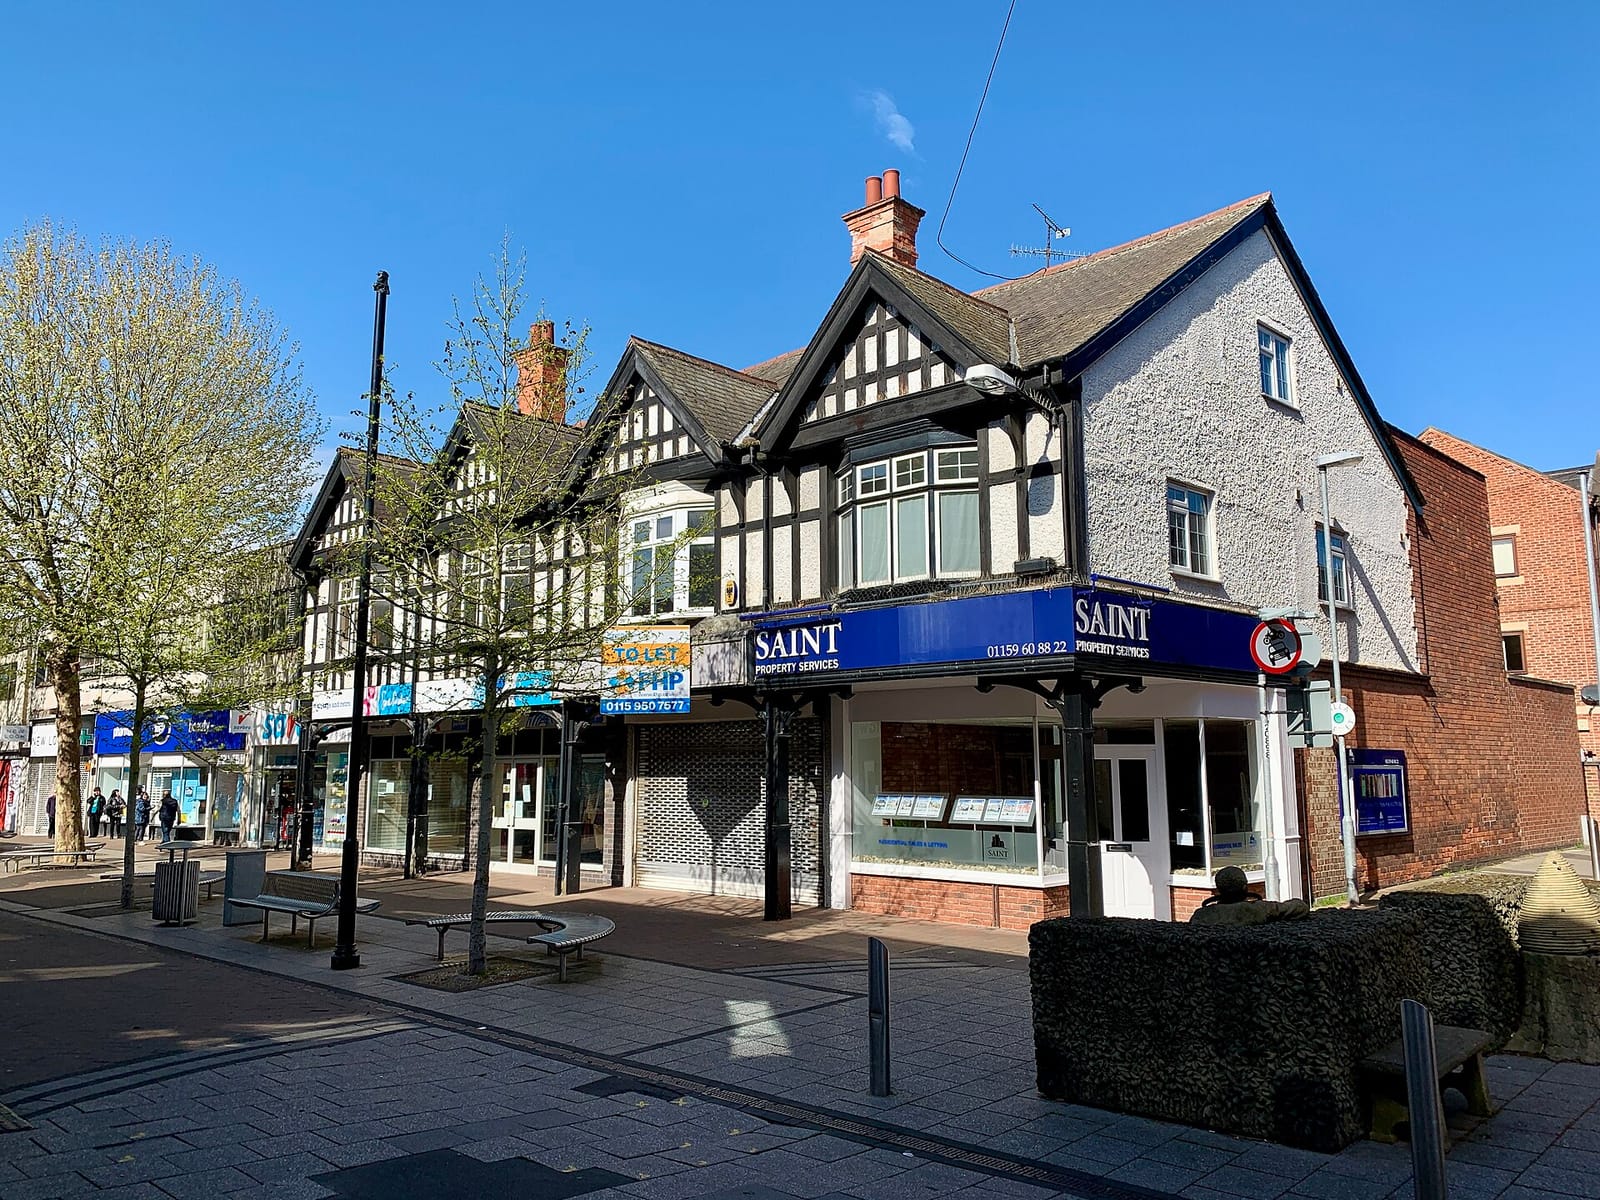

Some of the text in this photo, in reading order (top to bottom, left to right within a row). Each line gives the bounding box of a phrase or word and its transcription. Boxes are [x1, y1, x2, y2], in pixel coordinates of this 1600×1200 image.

[1075, 598, 1150, 641] SAINT
[755, 622, 843, 660] SAINT
[987, 640, 1067, 658] 01159 60 88 22
[1075, 640, 1150, 659] PROPERTY SERVICES
[614, 647, 680, 661] TO LET
[755, 658, 839, 675] PROPERTY SERVICES
[639, 671, 684, 691] FHP
[606, 700, 684, 712] 0115 950 7577
[987, 850, 1009, 858] SAINT
